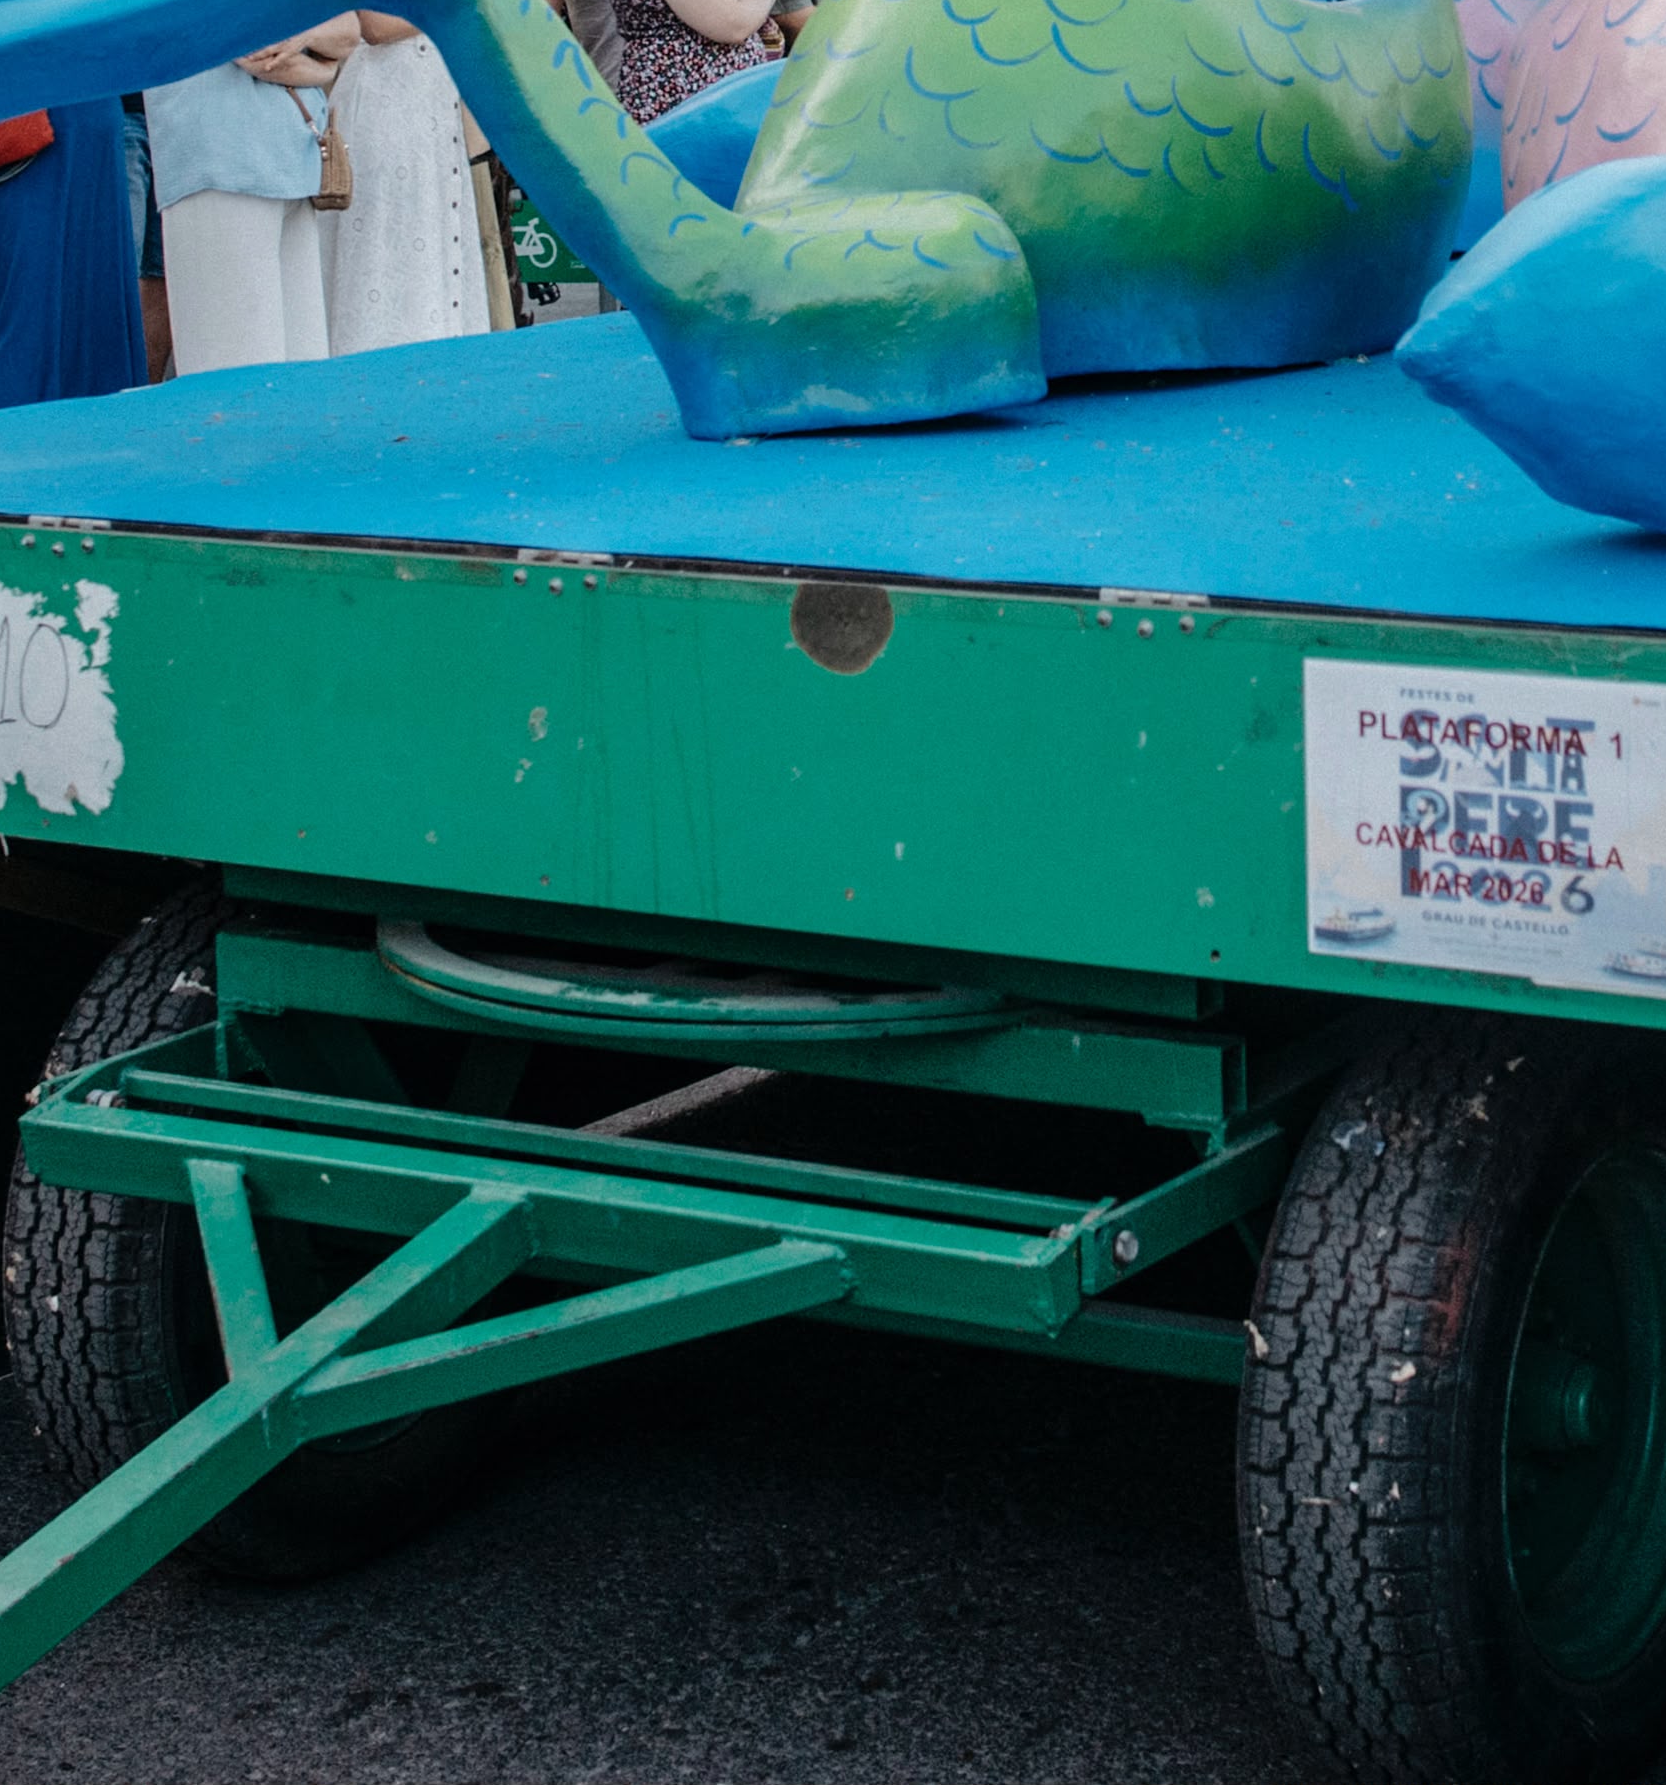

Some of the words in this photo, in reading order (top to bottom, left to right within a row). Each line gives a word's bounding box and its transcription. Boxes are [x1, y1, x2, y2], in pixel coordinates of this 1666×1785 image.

[1358, 710, 1588, 757] PLATAFORMA
[1609, 732, 1623, 759] 1
[1356, 822, 1529, 863] CAVALCADA
[1538, 840, 1576, 866] DE
[1587, 844, 1624, 870] LA
[1408, 867, 1473, 896] MAR
[1481, 876, 1545, 905] 2026
[1421, 910, 1464, 925] GRAU
[1468, 915, 1487, 927] DE
